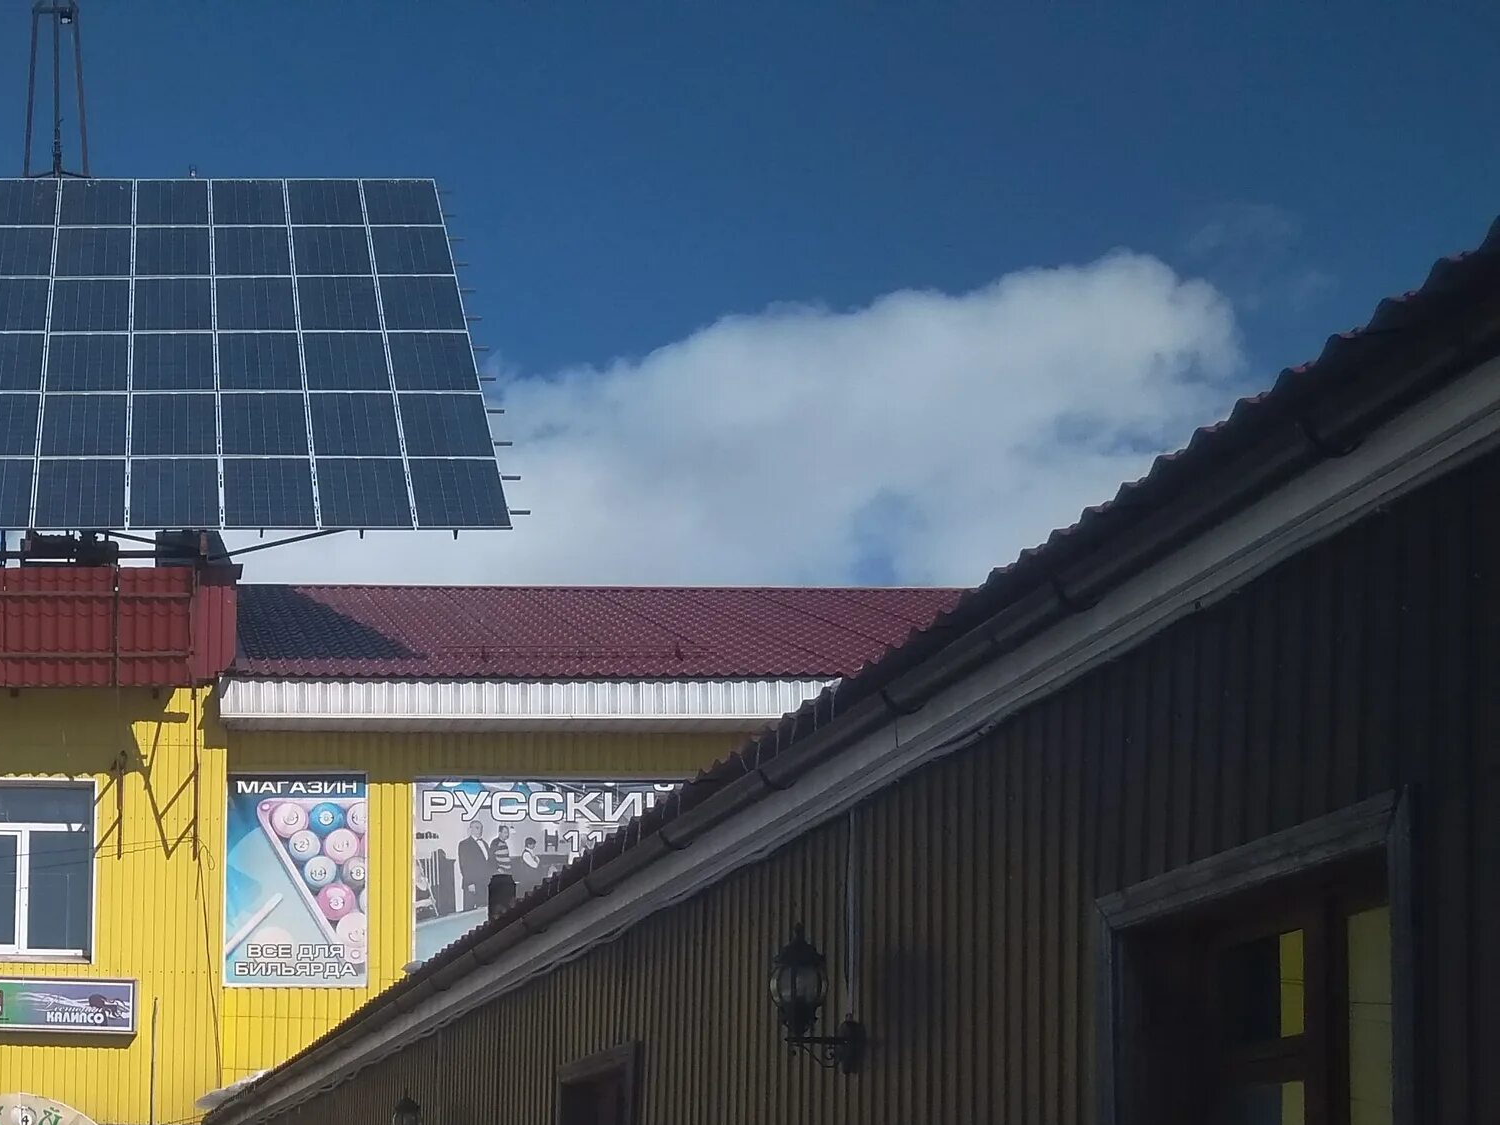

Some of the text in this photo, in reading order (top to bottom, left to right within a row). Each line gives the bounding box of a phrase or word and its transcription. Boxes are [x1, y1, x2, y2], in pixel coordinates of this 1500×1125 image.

[236, 780, 357, 794] МАГАЗИН
[247, 944, 344, 961] ВСЕ ДЛЯ
[235, 962, 358, 979] БИЛЬЯРДА
[46, 1011, 104, 1024] КАЛИПСО
